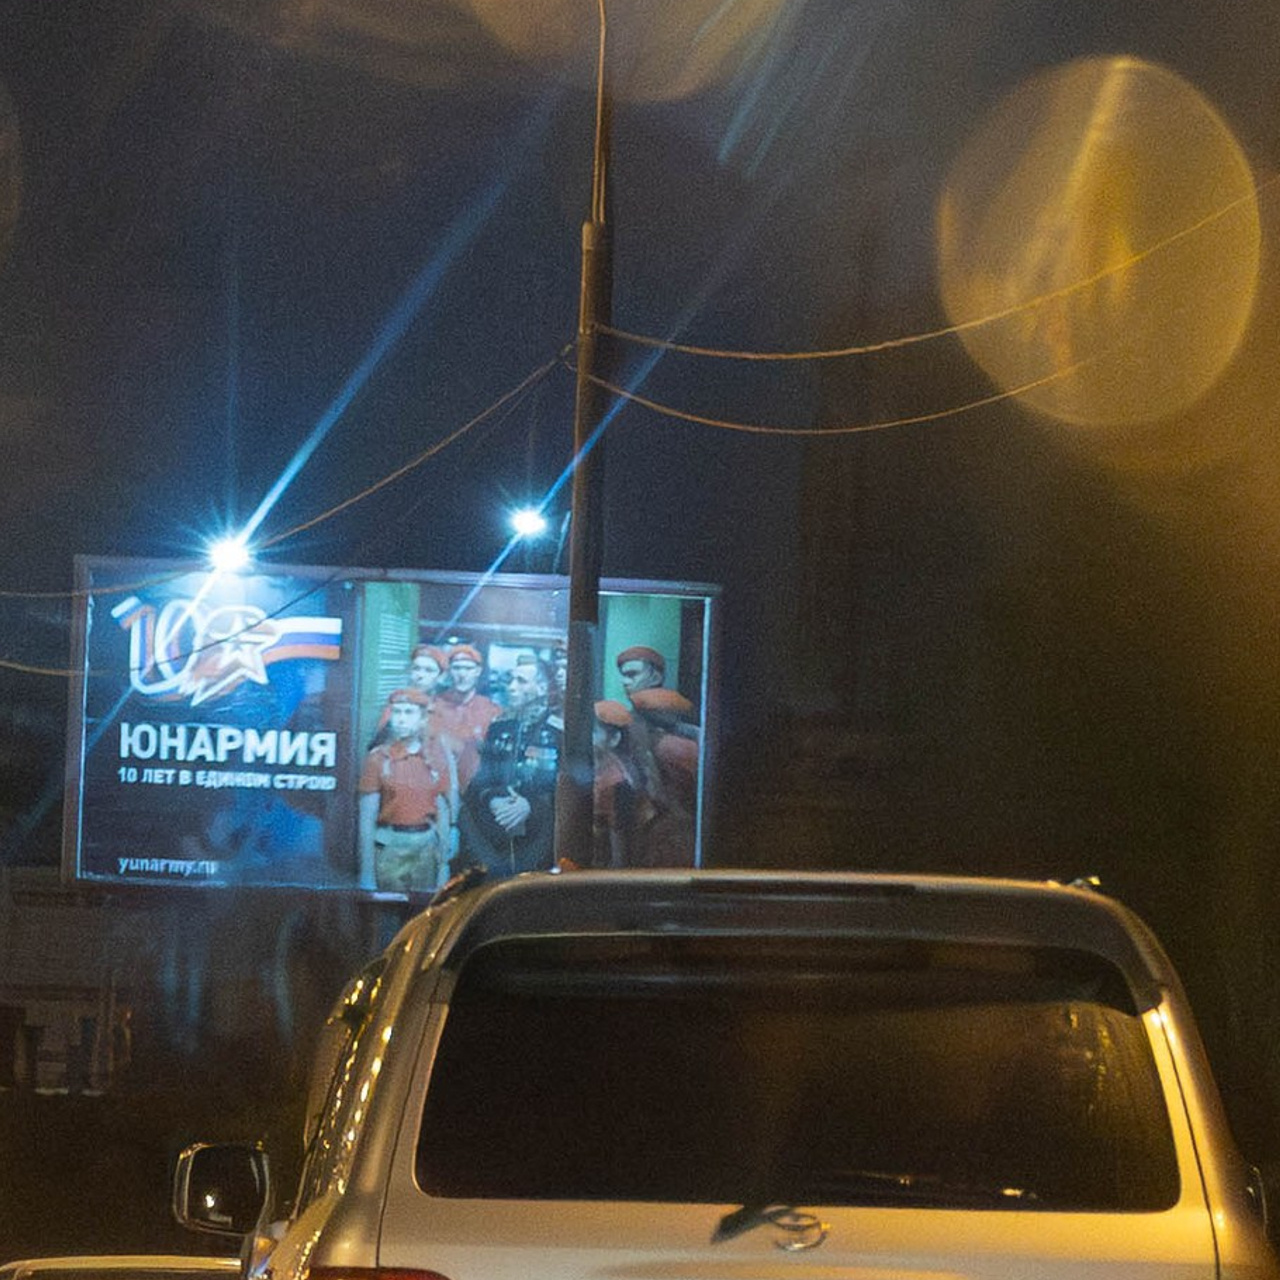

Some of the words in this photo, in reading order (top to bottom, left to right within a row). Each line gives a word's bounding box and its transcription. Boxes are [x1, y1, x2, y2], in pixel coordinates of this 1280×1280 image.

[119, 722, 337, 767] ЮНАРМИЯ
[118, 767, 138, 784] 10
[141, 768, 176, 785] ЛЕТ
[178, 769, 193, 786] В
[195, 770, 269, 789] ЕДИНОМ
